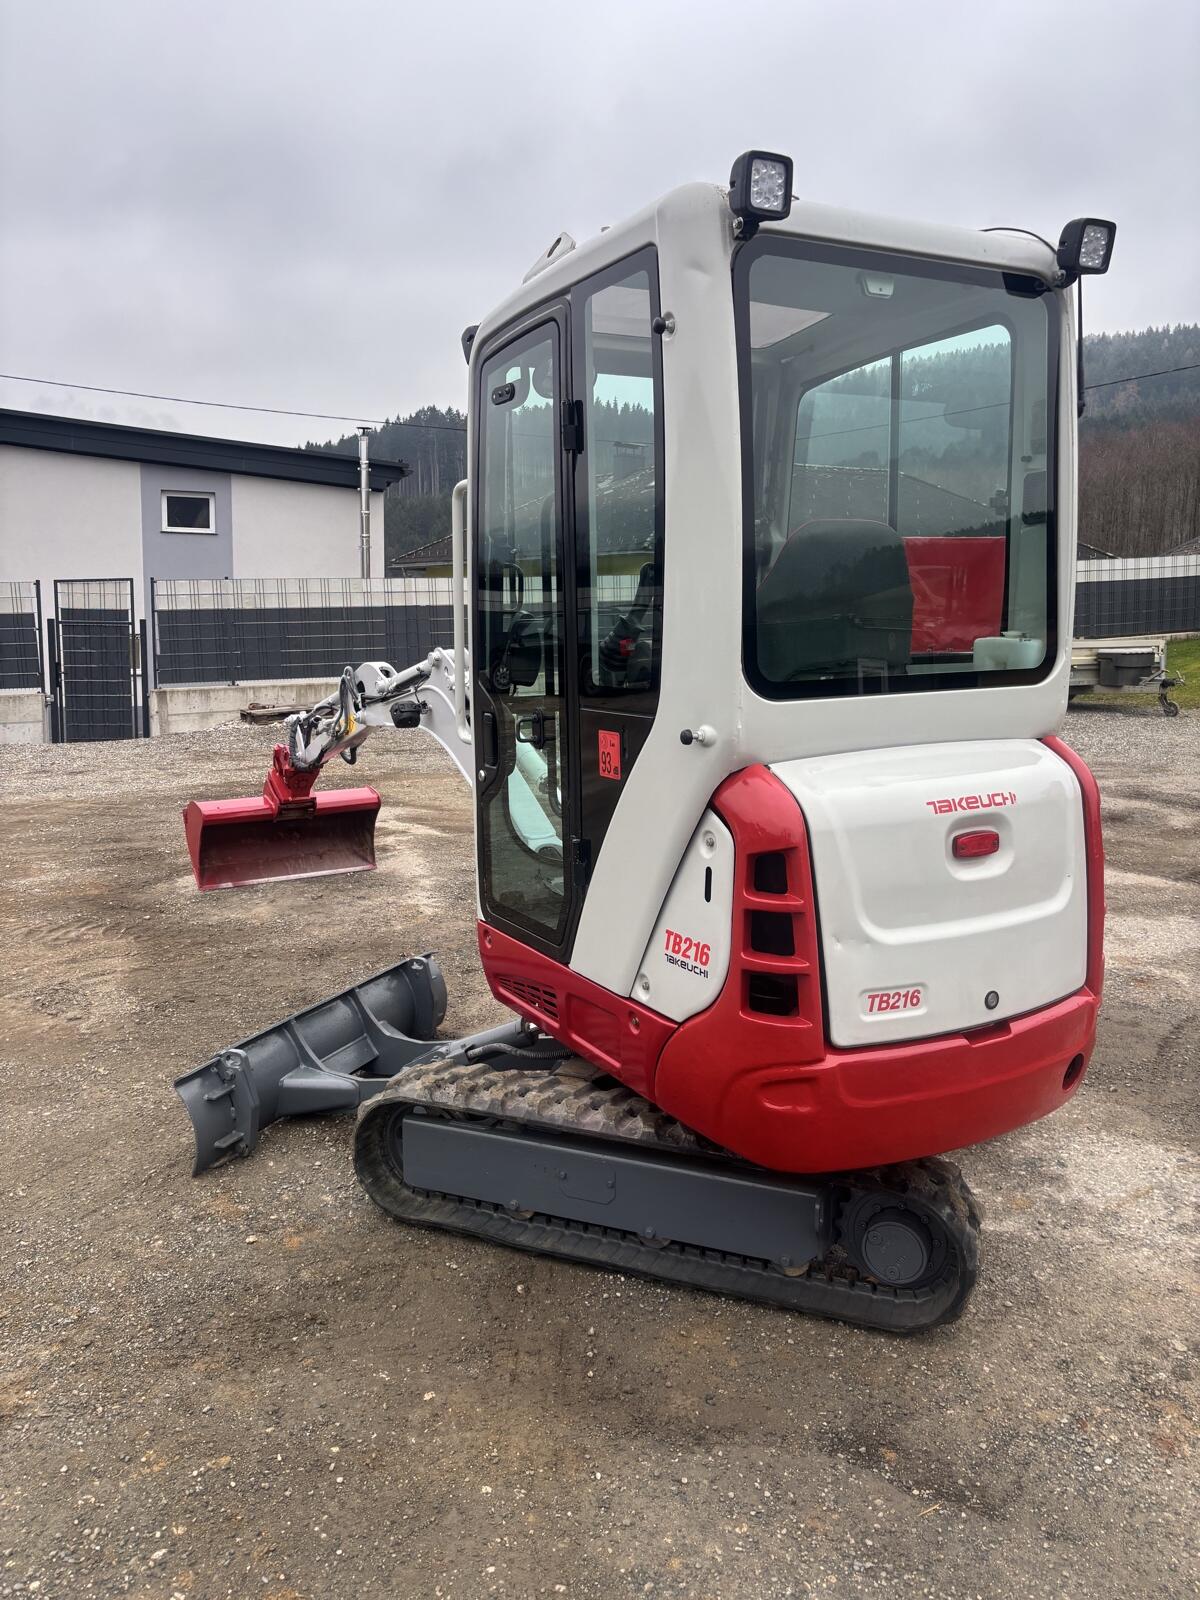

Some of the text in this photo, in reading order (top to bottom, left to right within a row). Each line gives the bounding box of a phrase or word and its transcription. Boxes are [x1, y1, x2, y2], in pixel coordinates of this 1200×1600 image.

[601, 751, 612, 774] 93
[664, 929, 711, 967] TB216
[867, 989, 921, 1013] TB216
